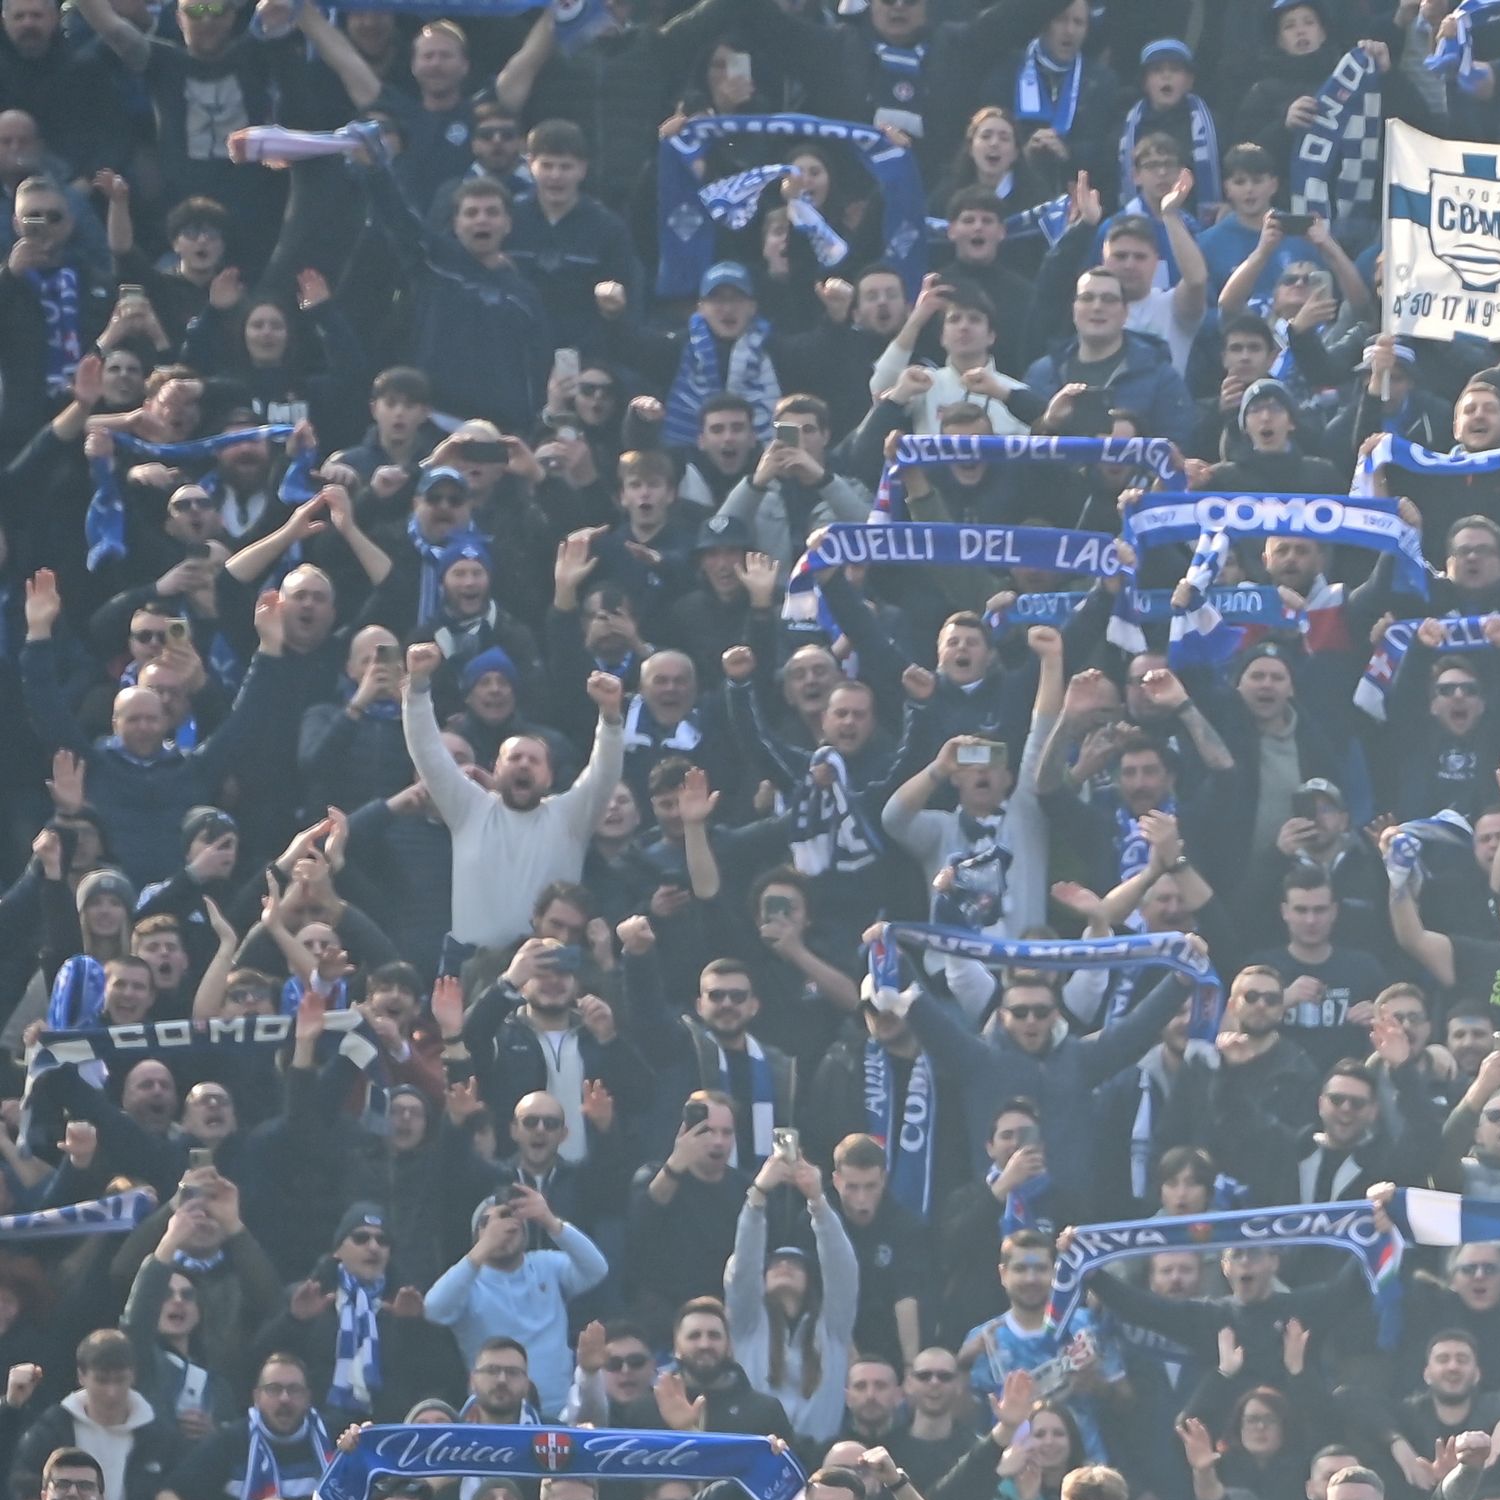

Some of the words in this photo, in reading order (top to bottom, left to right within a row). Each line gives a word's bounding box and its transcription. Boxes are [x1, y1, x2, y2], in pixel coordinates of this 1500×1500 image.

[1195, 496, 1346, 533] COMO
[816, 527, 934, 566] QUELLI
[959, 529, 1021, 564] DEL
[108, 1014, 293, 1049] COMO
[1239, 1210, 1381, 1247] COMO
